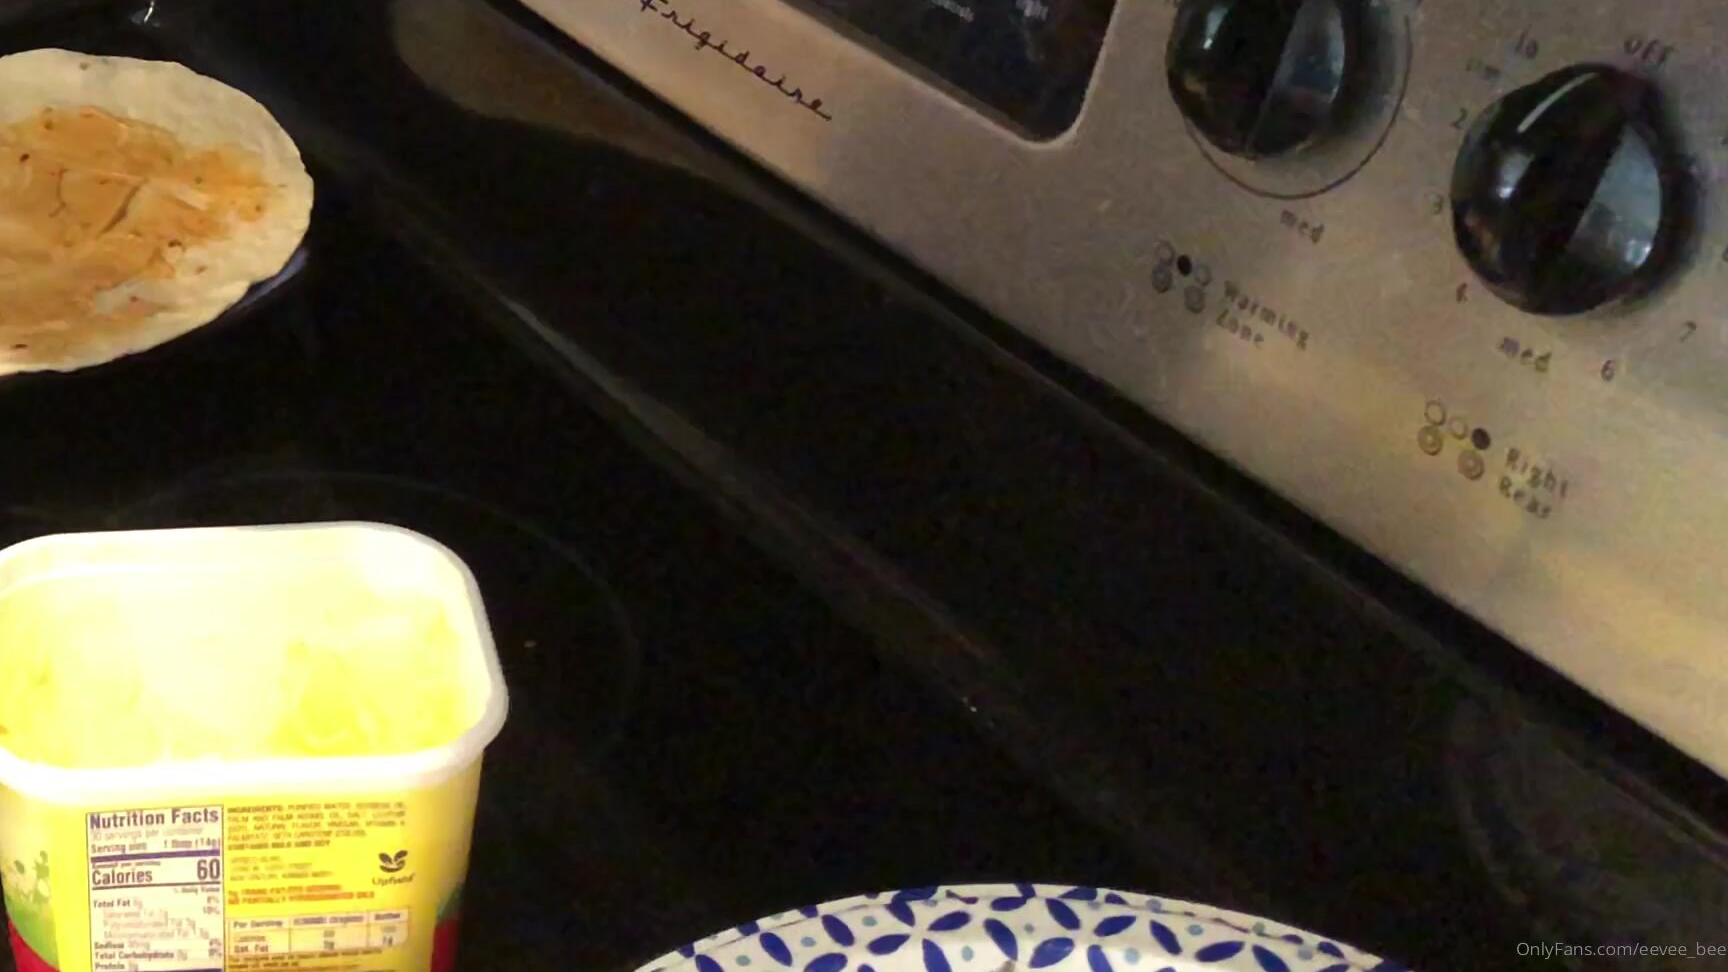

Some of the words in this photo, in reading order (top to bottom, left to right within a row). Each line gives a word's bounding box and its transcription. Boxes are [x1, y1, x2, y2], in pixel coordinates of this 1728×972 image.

[90, 810, 165, 830] Nutrition
[171, 807, 220, 824] Facts
[91, 869, 153, 886] Calories
[196, 858, 221, 881] 60
